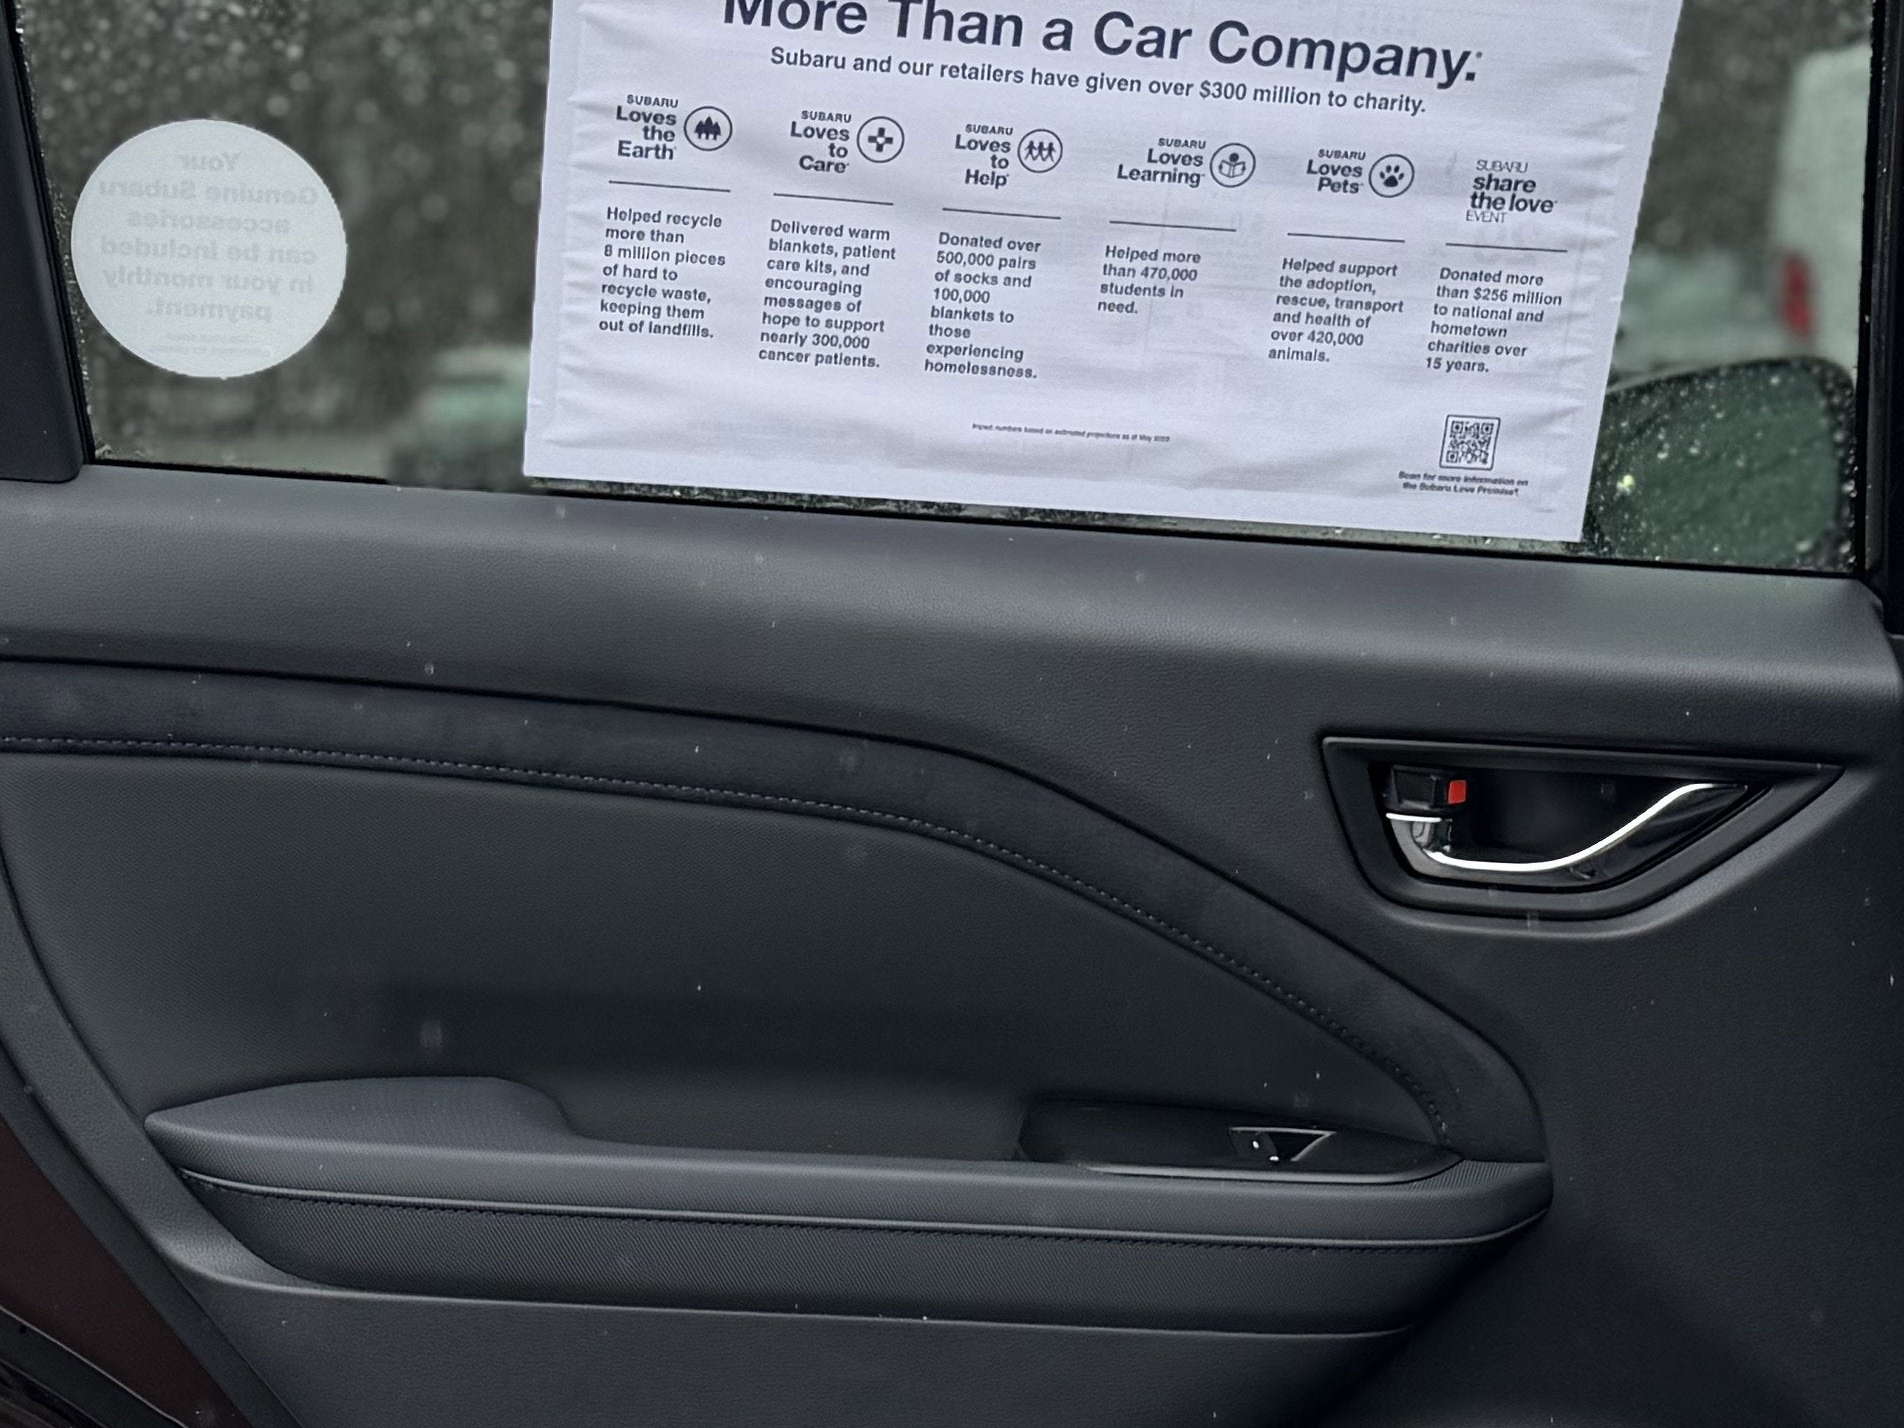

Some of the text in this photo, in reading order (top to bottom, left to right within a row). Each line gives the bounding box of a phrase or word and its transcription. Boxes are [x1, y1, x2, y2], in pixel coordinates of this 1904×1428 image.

[1041, 3, 1074, 52] a
[1093, 10, 1195, 60] Car
[770, 45, 1426, 117] Subaru and our retailers have given over $300 million to charity.
[626, 93, 679, 109] SUBARU
[615, 105, 677, 127] Loves
[801, 109, 852, 124] SUBARU
[642, 125, 676, 143] the
[790, 120, 850, 142] Loves
[965, 123, 1014, 136] SUBARU
[827, 142, 849, 159] to
[954, 133, 1011, 154] Loves
[1157, 137, 1207, 150] SUBARU
[990, 153, 1010, 170] to
[1147, 147, 1204, 168] Loves
[1317, 148, 1367, 161] SUBARU
[1305, 158, 1363, 178] Loves
[1475, 159, 1529, 173] SUBARU
[1472, 172, 1537, 194] share
[1470, 191, 1506, 211] the
[606, 206, 723, 229] Helped recycle
[1465, 209, 1506, 223] EVENT
[605, 227, 685, 244] more than
[770, 218, 891, 241] Delivered warm
[768, 237, 896, 261] blankets, patient
[938, 231, 1042, 253] Donated over
[603, 243, 726, 267] 8 million pieces
[936, 250, 1037, 271] 500,000 pairs
[1105, 244, 1202, 264] Helped more
[602, 263, 679, 281] of hard to
[766, 258, 871, 277] care kits, and
[1102, 263, 1199, 282] than 470,000
[1281, 257, 1399, 279] Helped support
[1439, 267, 1544, 287] Donated more
[764, 277, 862, 298] encouraging
[934, 269, 1033, 288] of socks and
[1279, 275, 1377, 296] the adoption,
[601, 283, 711, 305] recycle waste,
[933, 287, 991, 305] 100,000
[1099, 281, 1184, 299] students in
[1436, 285, 1563, 307] than $256 million
[600, 298, 705, 320] keeping them
[763, 295, 863, 314] messages of
[930, 305, 1015, 324] blankets to
[1097, 300, 1139, 315] need.
[1275, 294, 1404, 315] rescue, transport
[1433, 303, 1545, 323] to national and
[598, 319, 714, 339] out of landfills.
[761, 311, 885, 334] hope to support
[1272, 311, 1372, 329] and health of
[1430, 319, 1508, 338] hometown
[760, 331, 871, 349] nearly 300,000
[928, 323, 971, 339] those
[1270, 329, 1365, 347] over 420,000
[925, 343, 1024, 363] experiencing
[1267, 346, 1330, 363] animals.
[1427, 339, 1528, 357] charities over
[758, 349, 880, 369] cancer patients.
[924, 358, 1037, 379] homelessness.
[1426, 356, 1489, 373] 15 years.
